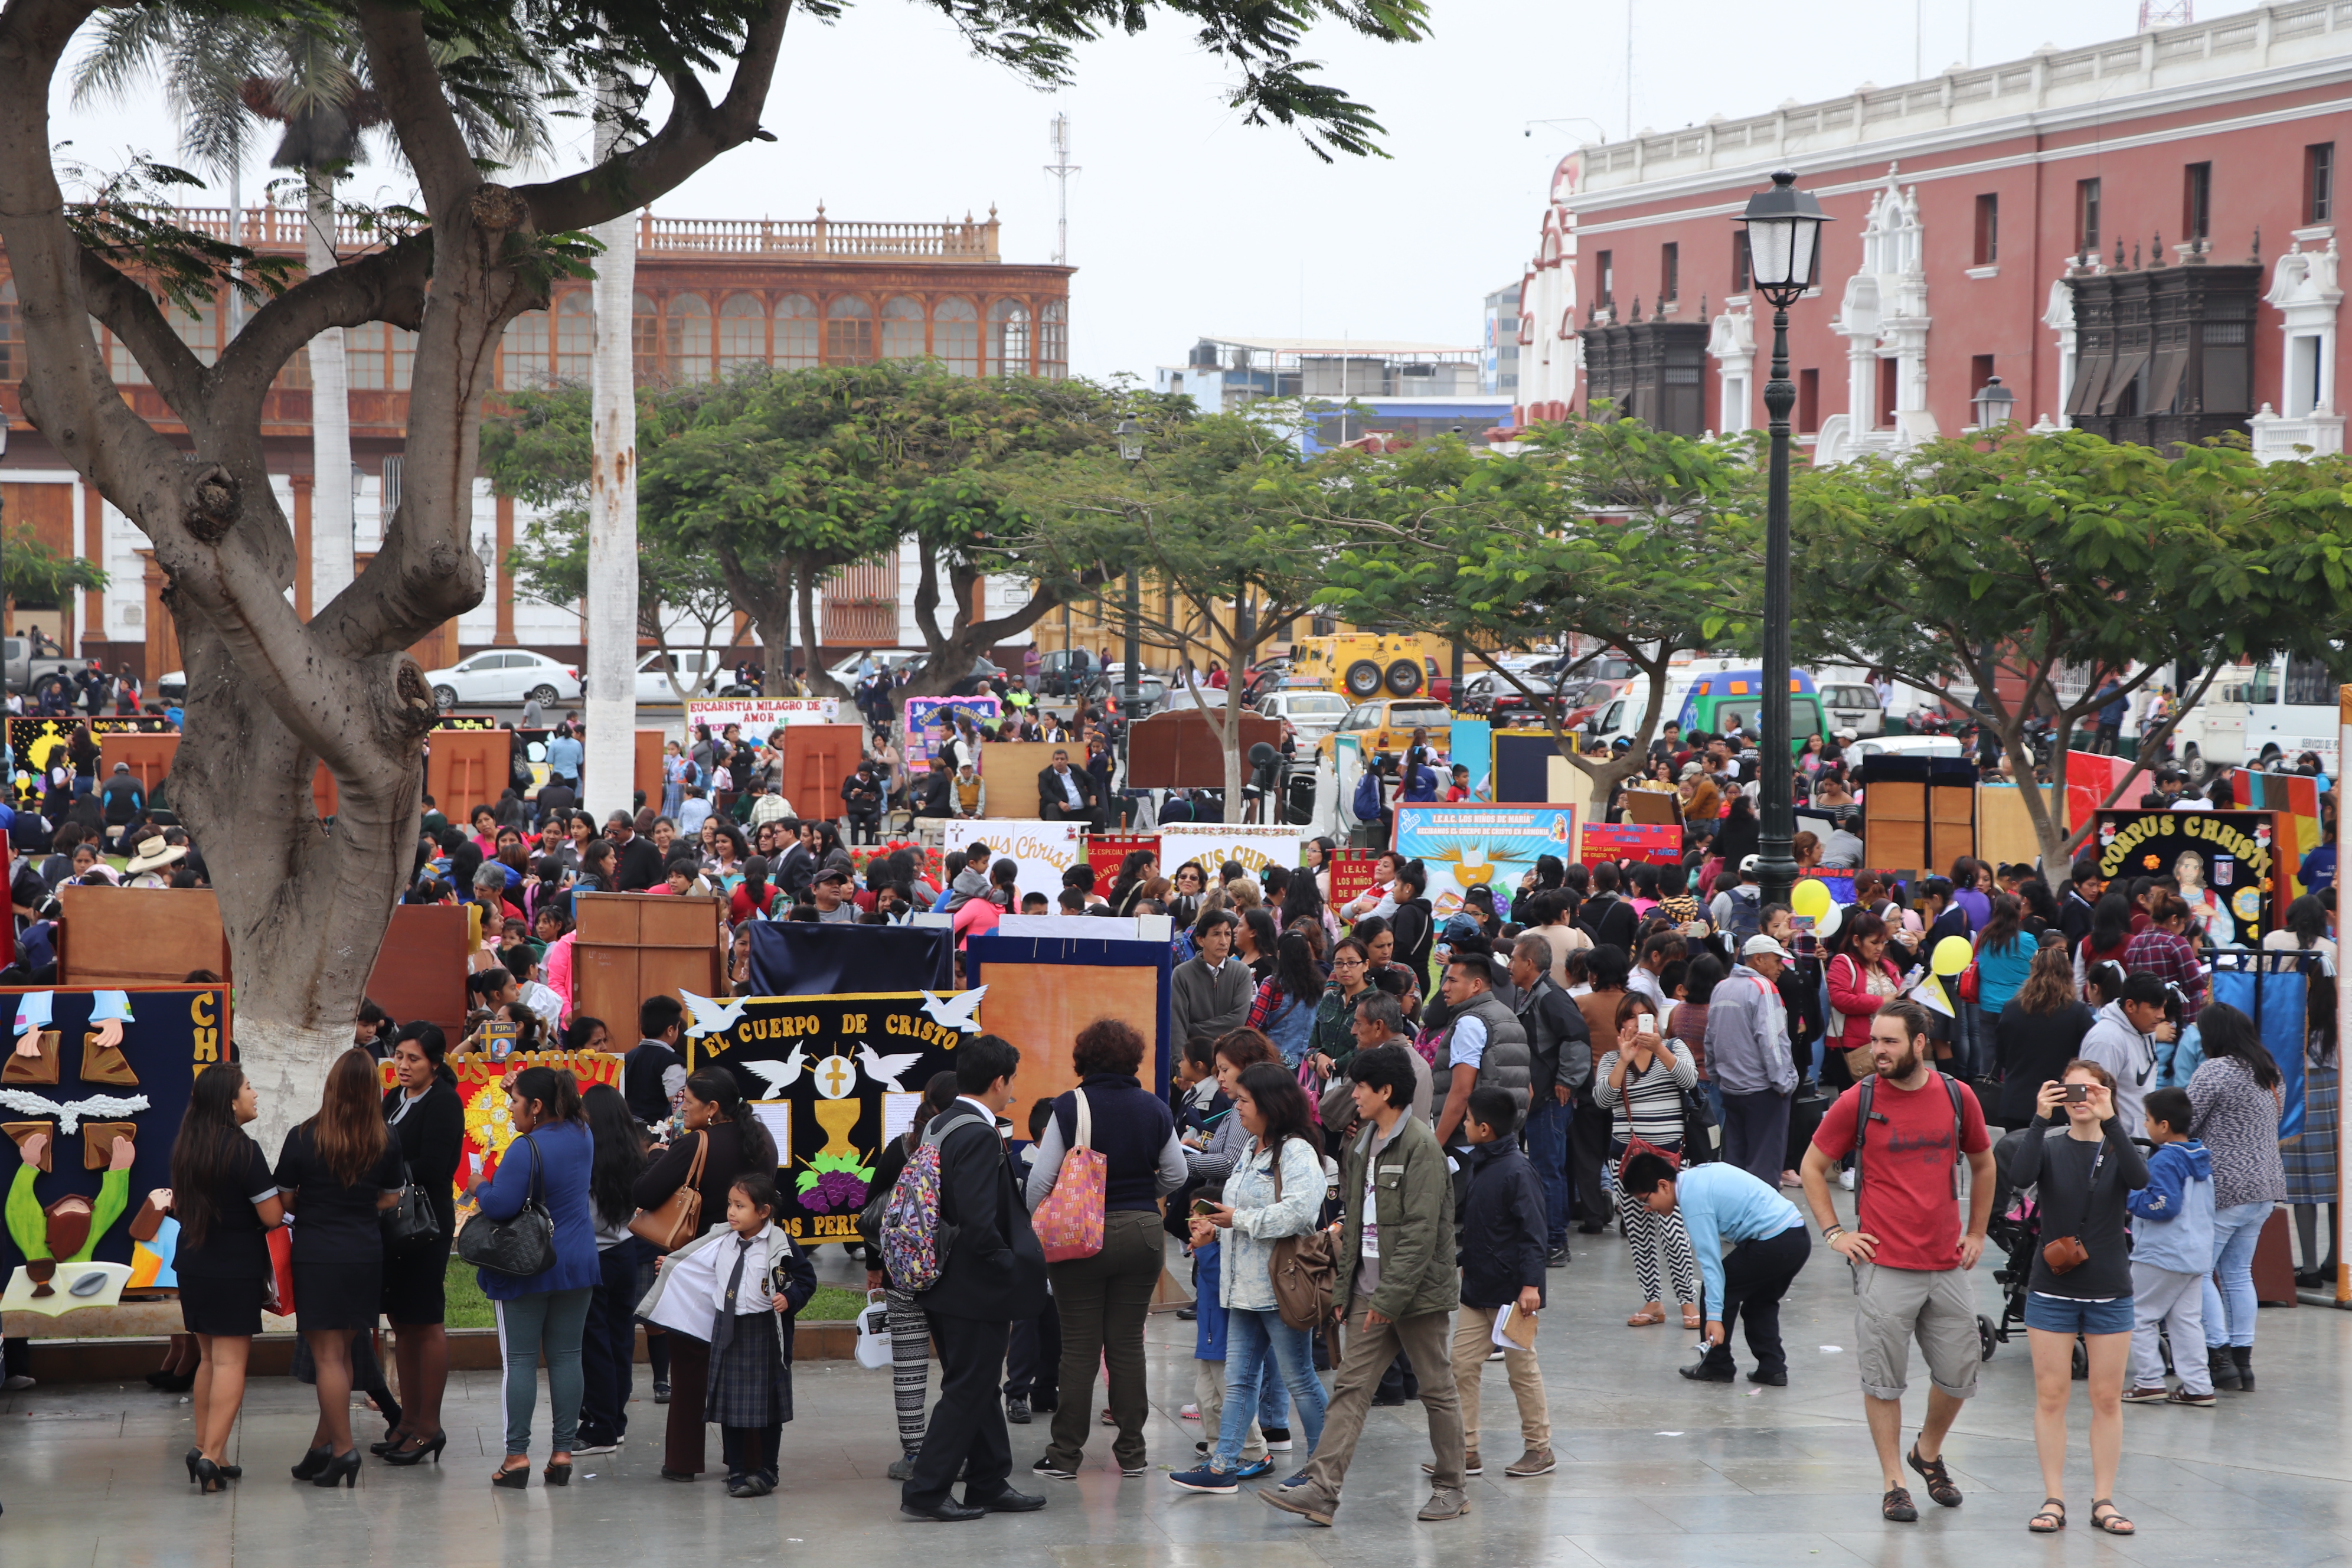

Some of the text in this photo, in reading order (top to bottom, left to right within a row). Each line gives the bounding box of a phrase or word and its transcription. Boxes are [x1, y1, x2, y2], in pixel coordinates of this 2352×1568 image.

[690, 701, 821, 713] EUCARISTIA MILAGRO DE
[744, 713, 775, 723] AMOR
[953, 704, 985, 725] CHRISTI
[694, 716, 705, 724] SE
[778, 717, 790, 726] SE
[2302, 738, 2325, 749] SERVICIO
[2325, 739, 2333, 749] DE
[1402, 810, 1410, 819] 3
[1433, 815, 1457, 823] I.E.A.C.
[1459, 815, 1472, 823] LOS
[1474, 812, 1495, 823] NIÑOS
[1623, 824, 1646, 832] NIÑOS
[2099, 815, 2175, 877] CORPUS
[1657, 847, 1678, 856] AÑOS
[1095, 863, 1119, 881] SANTO
[1810, 867, 1840, 877] NIÑOS
[1841, 868, 1854, 877] DE
[1337, 876, 1373, 886] LOS NIÑOS
[1338, 889, 1348, 897] DE
[702, 1014, 959, 1058] EL CUERPO DE CRISTO
